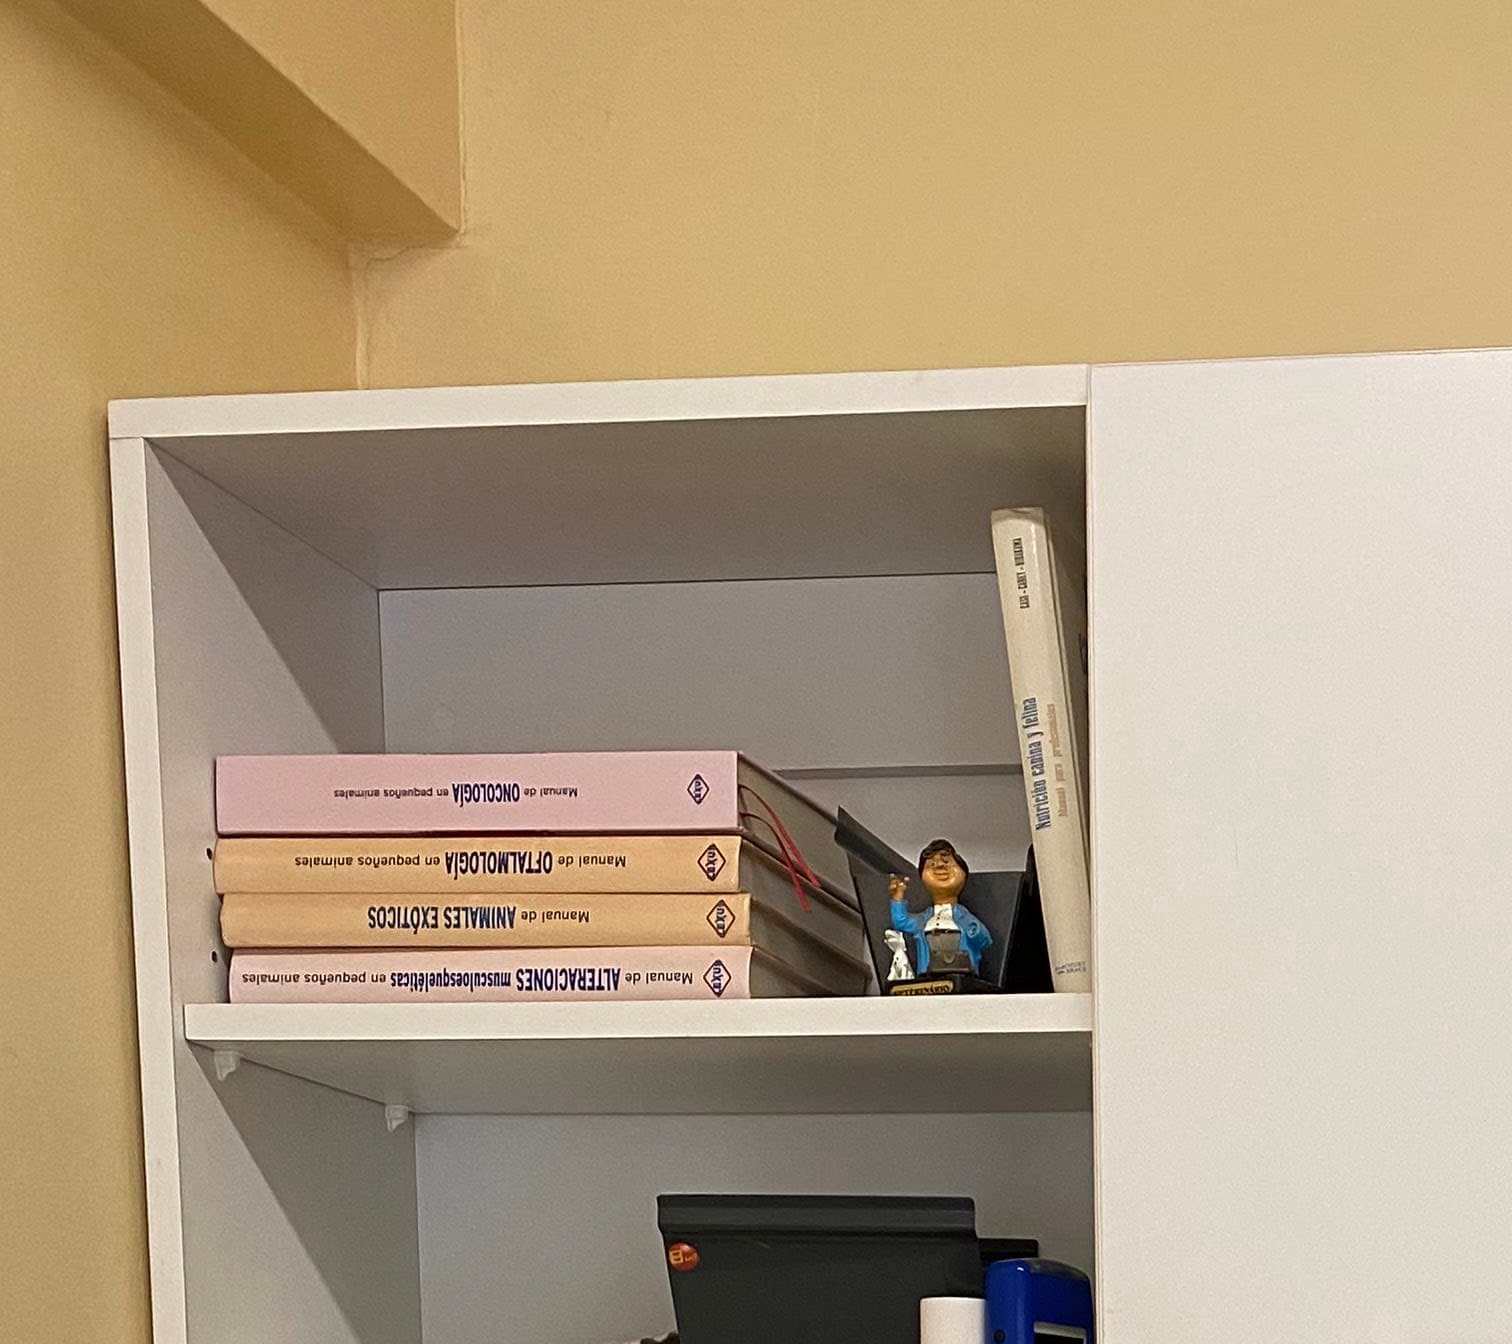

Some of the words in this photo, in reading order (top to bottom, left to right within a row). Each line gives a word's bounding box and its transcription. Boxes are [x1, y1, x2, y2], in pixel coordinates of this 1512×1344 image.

[1022, 697, 1038, 728] felina
[1029, 741, 1044, 776] canina
[334, 788, 380, 799] animales
[384, 788, 433, 799] pequeños
[436, 788, 449, 797] en
[452, 783, 520, 808] ONCOLOGÍA
[524, 787, 537, 797] de
[540, 787, 578, 797] Manual
[295, 856, 353, 868] animales
[357, 855, 420, 868] pequeños
[425, 856, 441, 866] en
[444, 850, 553, 880] OFTALMOLOGÍA
[557, 855, 574, 867] de
[578, 855, 627, 867] Manual
[367, 906, 439, 935] EXÓTICOS
[443, 906, 516, 929] ANIMALES
[521, 910, 537, 922] de
[542, 910, 590, 923] Manual
[242, 973, 300, 985] animales
[304, 971, 366, 985] pequeños
[371, 973, 386, 983] en
[391, 967, 511, 992] musculoesqueléticas
[516, 967, 621, 991] ALTERACIONES
[625, 972, 640, 984] de
[645, 972, 693, 984] Manual
